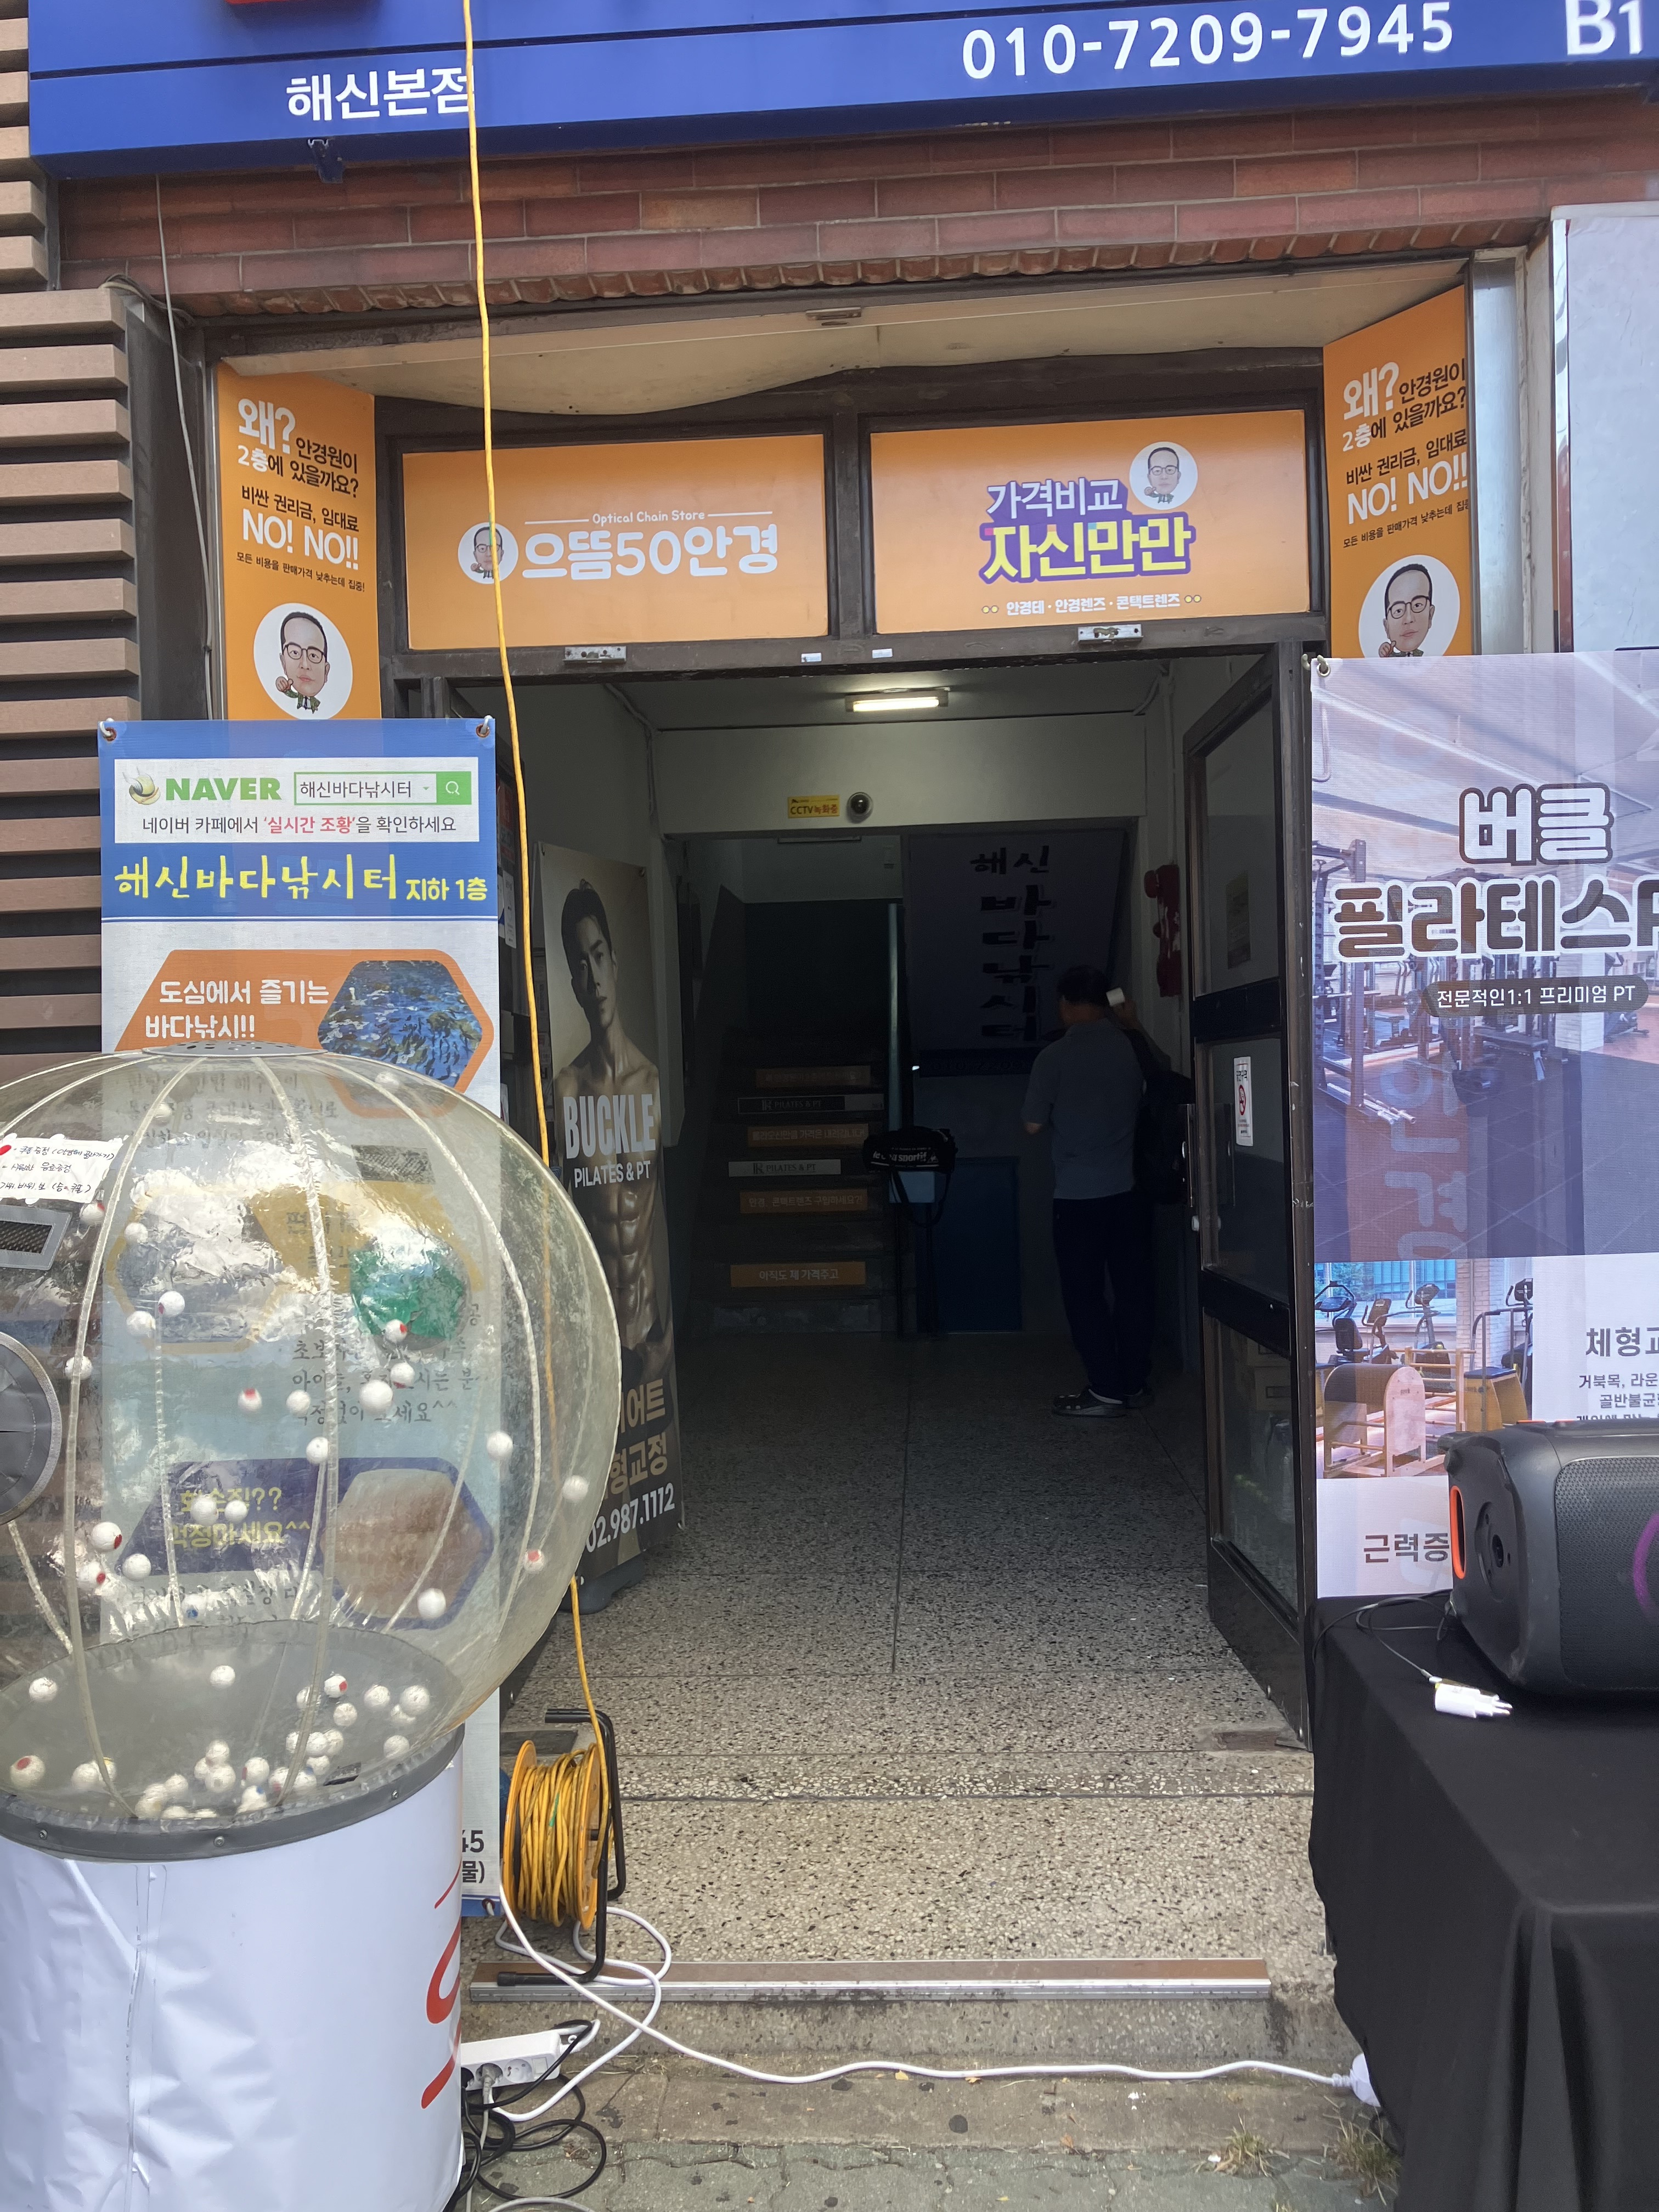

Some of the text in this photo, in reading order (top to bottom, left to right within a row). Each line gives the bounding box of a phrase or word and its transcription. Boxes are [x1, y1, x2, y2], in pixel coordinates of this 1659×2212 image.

[962, 1, 1453, 79] 010-7209-7945
[286, 65, 475, 121] 해신본점
[1343, 358, 1466, 421] 왜? 안경원이
[238, 398, 358, 474] 왜? 안경원이
[1342, 386, 1466, 452] 2층에 있을까요?
[238, 444, 359, 498] 2층에 있을까요?
[1346, 428, 1468, 486] 비싼 권리금, 임대료
[241, 485, 359, 532] 비싼 권리금, 임대료
[986, 478, 1123, 520] 가격비교
[1347, 452, 1469, 525] NO! NO!!
[242, 508, 358, 570] NO! NO!!
[592, 509, 706, 527] Optical Chain Store
[1343, 535, 1358, 549] 모든
[1361, 527, 1383, 543] 비용을
[1386, 516, 1418, 535] 판매가격
[1420, 505, 1453, 526] 낮추는데
[522, 524, 778, 580] 으뜸50안경
[983, 516, 1193, 580] 자신만만
[236, 552, 365, 593] 모든 비용을 판매가격 낮추는데 집중!
[1006, 599, 1045, 616] 안경테
[1055, 597, 1105, 613] 안경렌즈
[166, 777, 282, 801] NAVER
[300, 780, 412, 799] 해신바다낚시터
[143, 816, 190, 834] 네이버
[195, 816, 258, 834] 카페에서
[376, 816, 456, 834] 확인하세요
[1460, 784, 1613, 865] 버클
[406, 878, 449, 901] 지하
[456, 877, 488, 901] 1층
[159, 980, 329, 1005] 도심에서 즐기는
[1437, 985, 1635, 1008] 전문적인1:1 프리미엄 PT
[145, 1015, 255, 1039] 바다낚시!!
[563, 1093, 656, 1159] BUCKLE
[574, 1160, 651, 1188] PILATES & PT
[766, 1164, 797, 1172] PILATES
[759, 1270, 788, 1281] 아직도
[1579, 1373, 1658, 1389] 거북목, 라운
[1600, 1392, 1659, 1409] 골반불균
[620, 1379, 666, 1434] 어트
[603, 1432, 668, 1500] 형교정
[586, 1482, 675, 1553] 02.987.1112
[1363, 1533, 1450, 1564] 근력증
